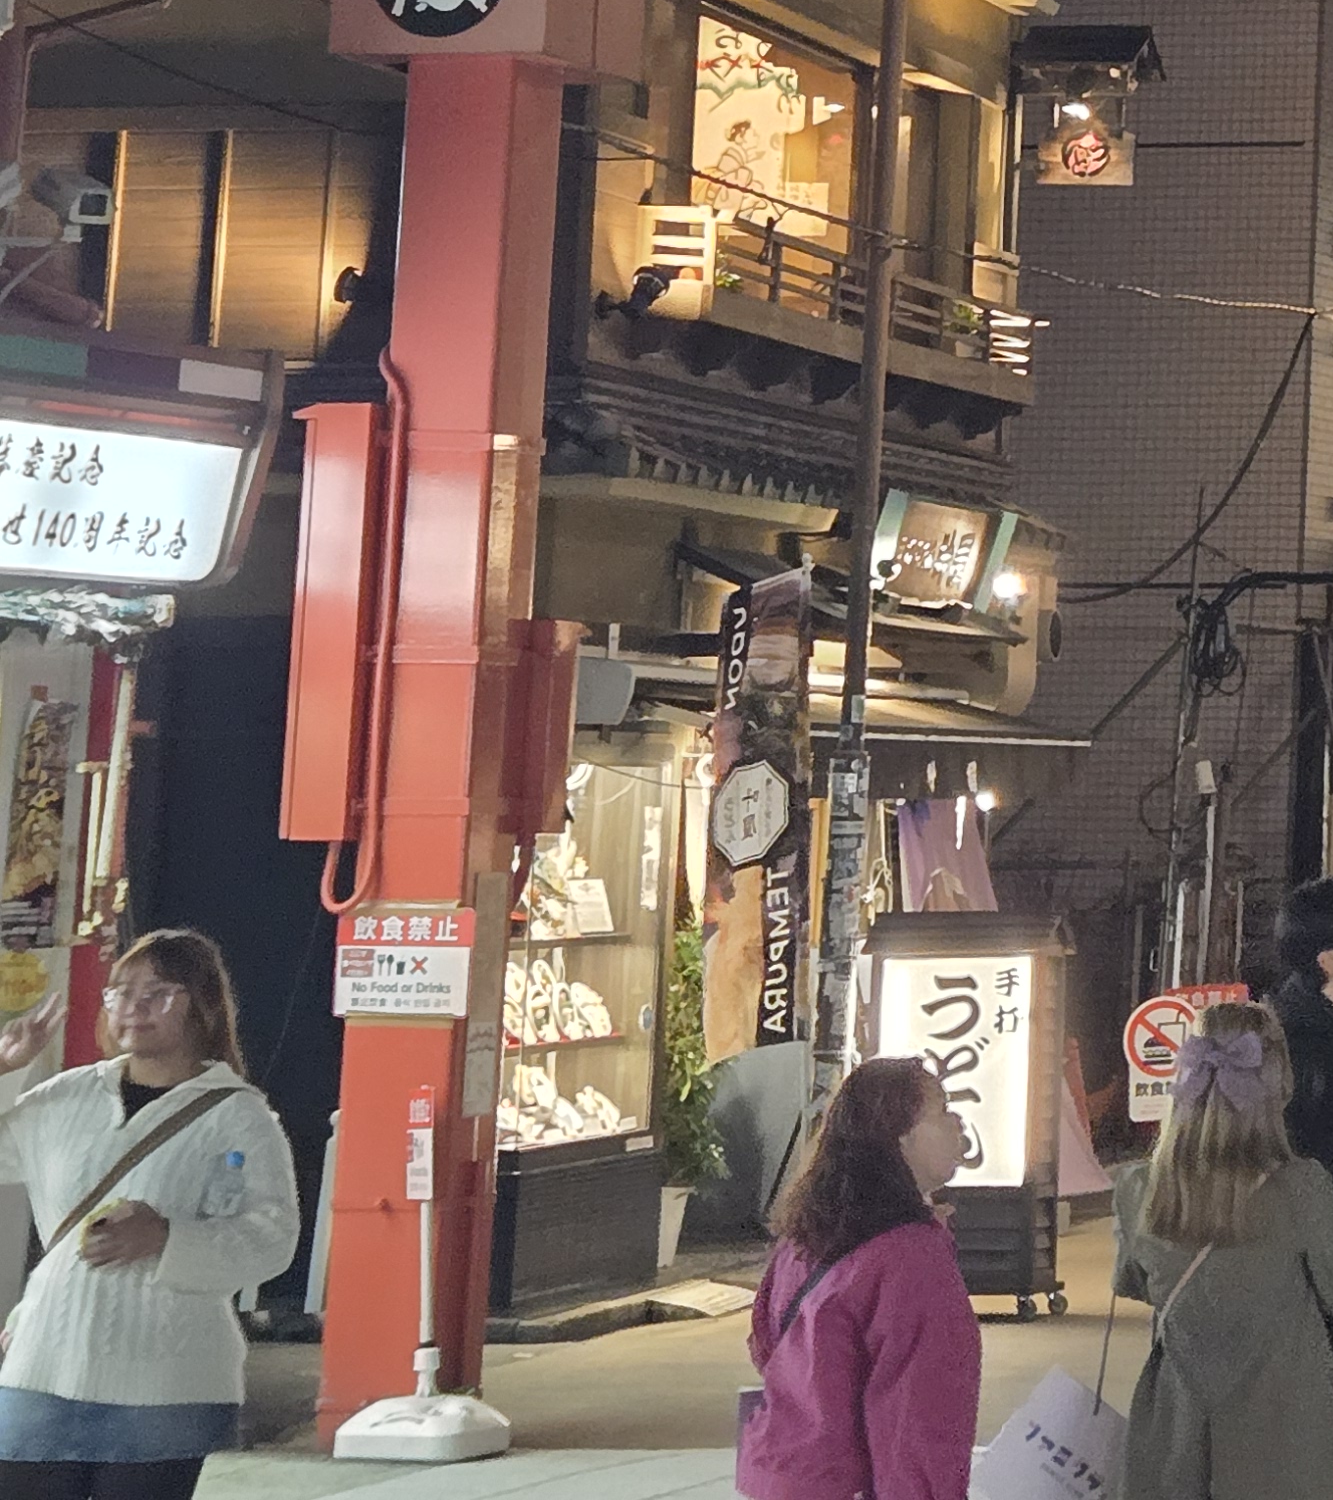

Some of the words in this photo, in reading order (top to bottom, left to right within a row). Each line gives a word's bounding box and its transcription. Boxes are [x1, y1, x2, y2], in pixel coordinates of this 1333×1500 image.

[353, 915, 459, 942] 飲食禁止
[351, 981, 368, 994] No
[370, 981, 399, 994] Food
[400, 984, 414, 994] or
[415, 982, 452, 995] Drinks
[993, 967, 1021, 1034] 手打
[1135, 1080, 1172, 1098] 飲食
